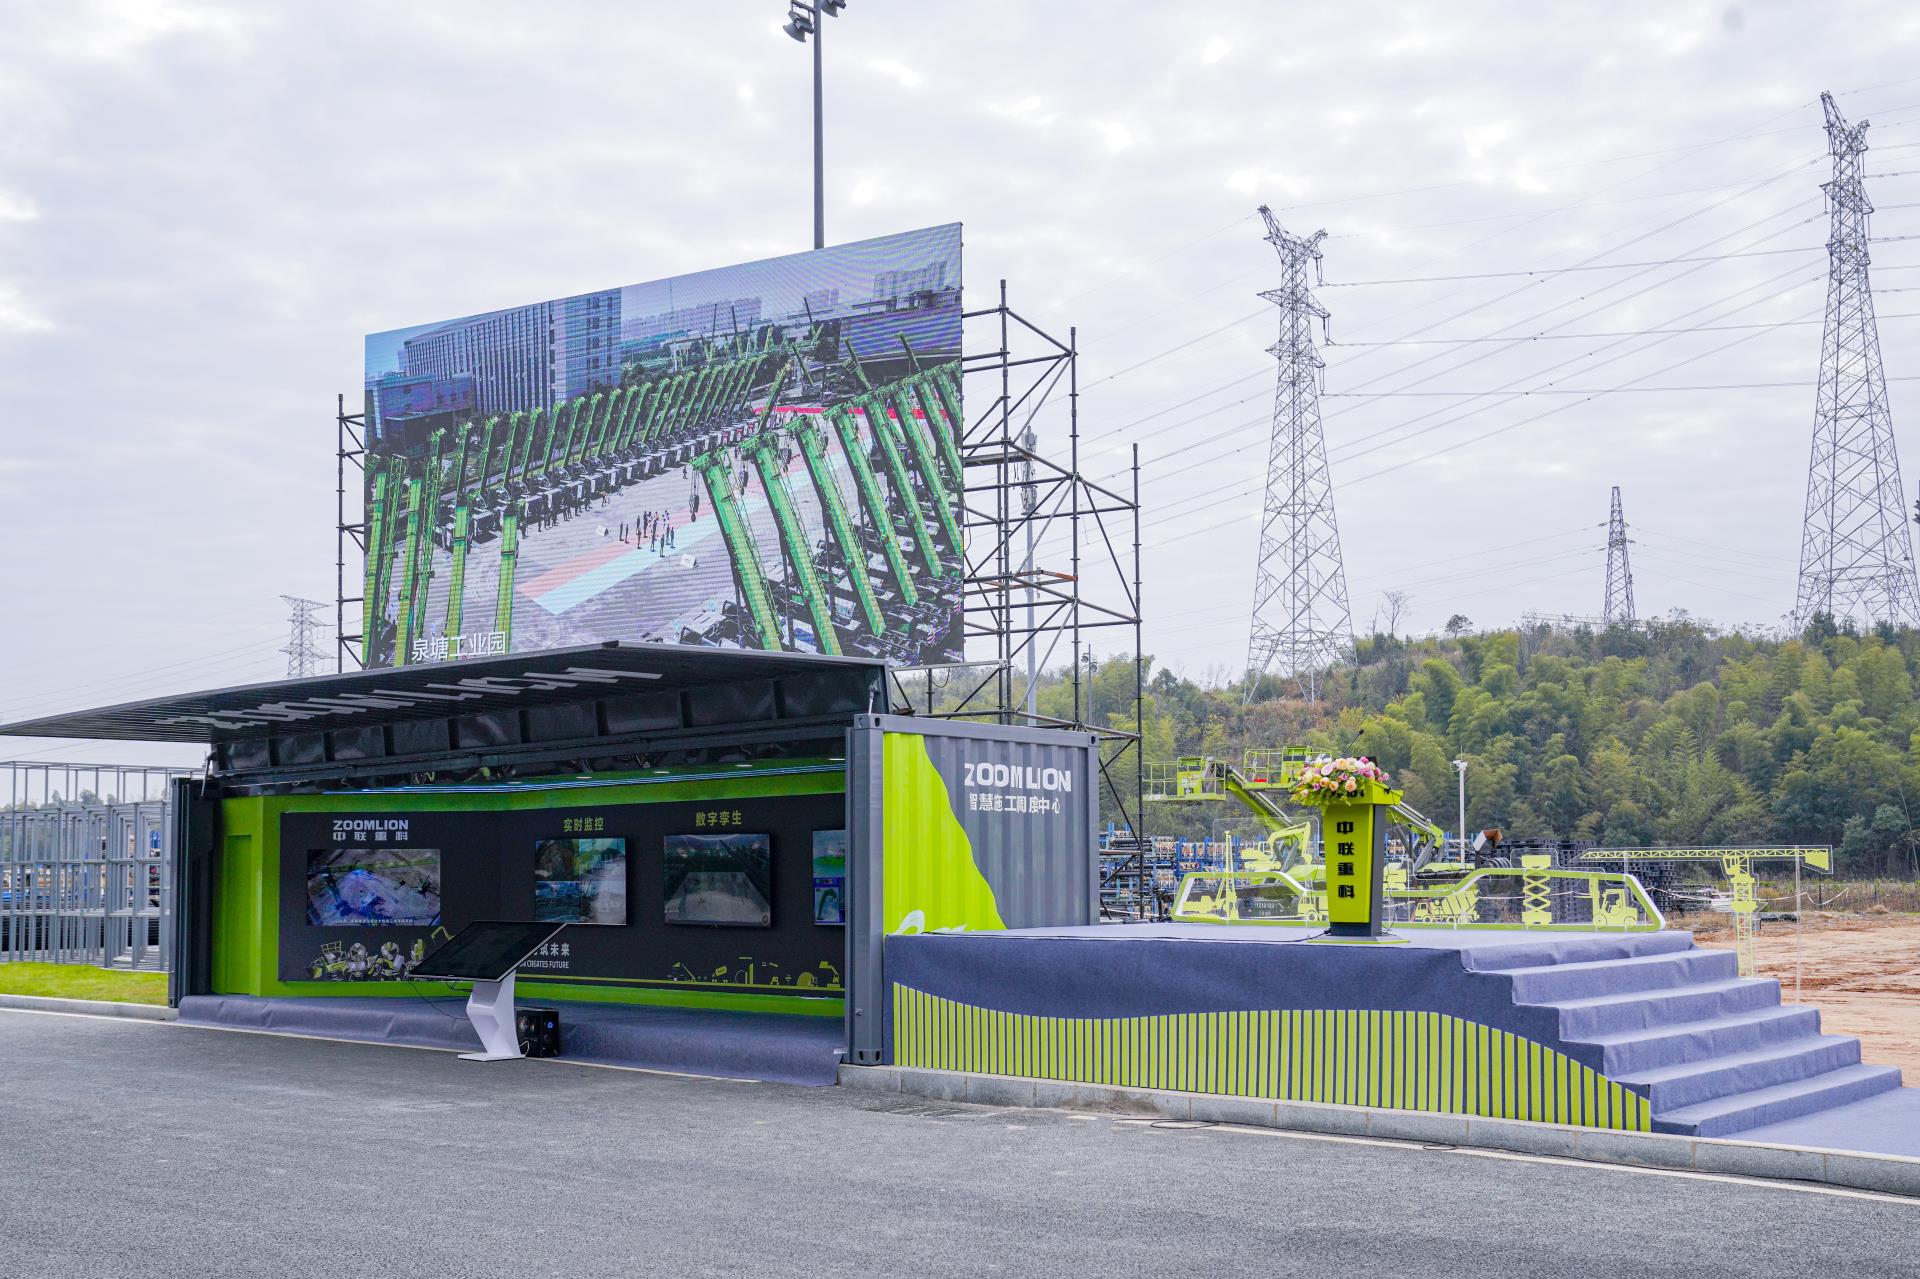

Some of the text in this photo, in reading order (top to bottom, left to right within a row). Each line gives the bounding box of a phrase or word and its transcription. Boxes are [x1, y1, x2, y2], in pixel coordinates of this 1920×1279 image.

[411, 631, 506, 661] 泉塘工业园
[963, 762, 1072, 792] ZOOMLION
[969, 792, 1061, 815] 智慧施工调度中心
[332, 819, 409, 831] ZOOMLION
[563, 817, 604, 832] 实时监控
[695, 810, 742, 827] 数字孪生
[332, 831, 409, 841] 中联重科
[1336, 821, 1355, 899] 中联重科
[526, 959, 549, 968] CREATES
[549, 960, 570, 969] FUTURE
